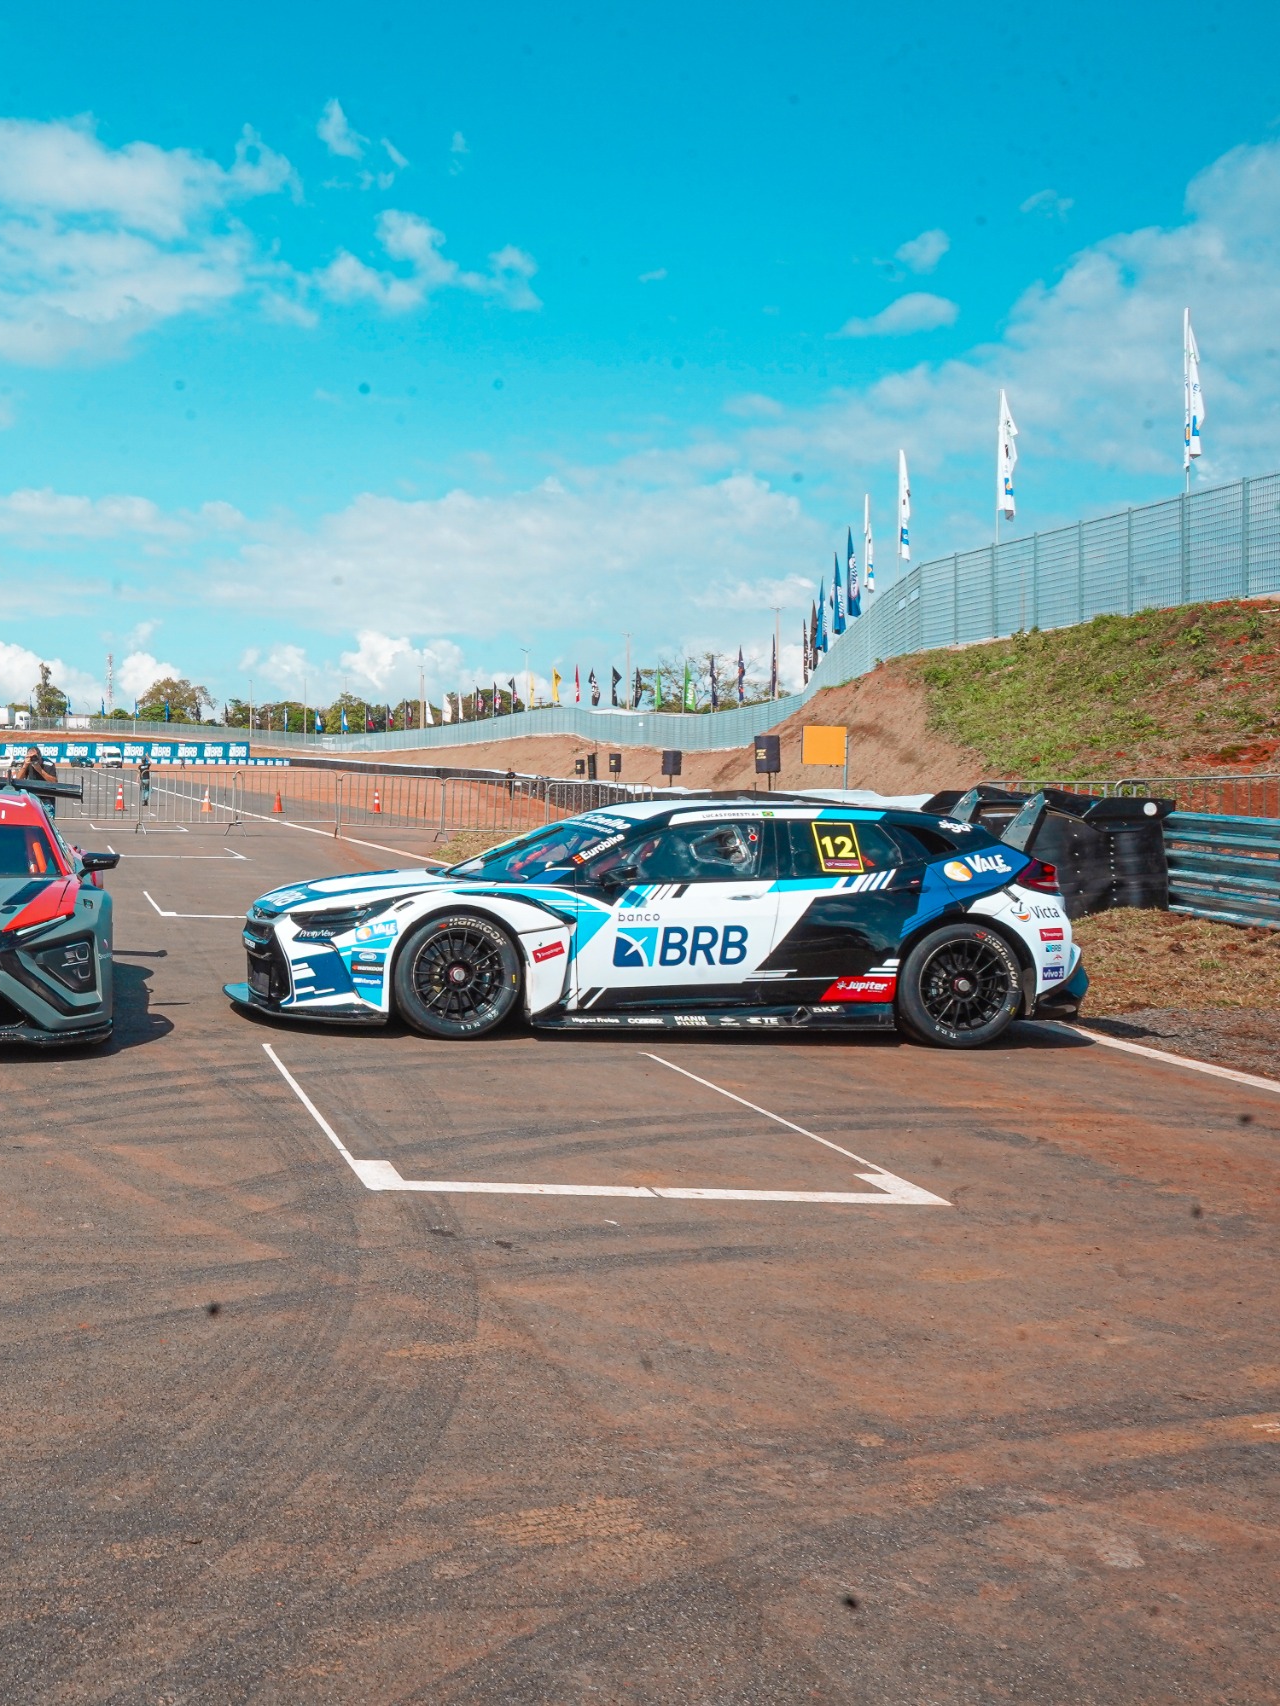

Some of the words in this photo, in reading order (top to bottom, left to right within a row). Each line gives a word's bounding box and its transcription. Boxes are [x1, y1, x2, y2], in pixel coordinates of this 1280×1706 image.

[578, 834, 625, 860] Eurobike
[820, 836, 856, 858] 12
[964, 854, 1007, 873] VALE
[617, 912, 661, 922] banco
[1030, 905, 1061, 919] Victa
[659, 925, 749, 967] BRB
[1043, 968, 1059, 978] vivo
